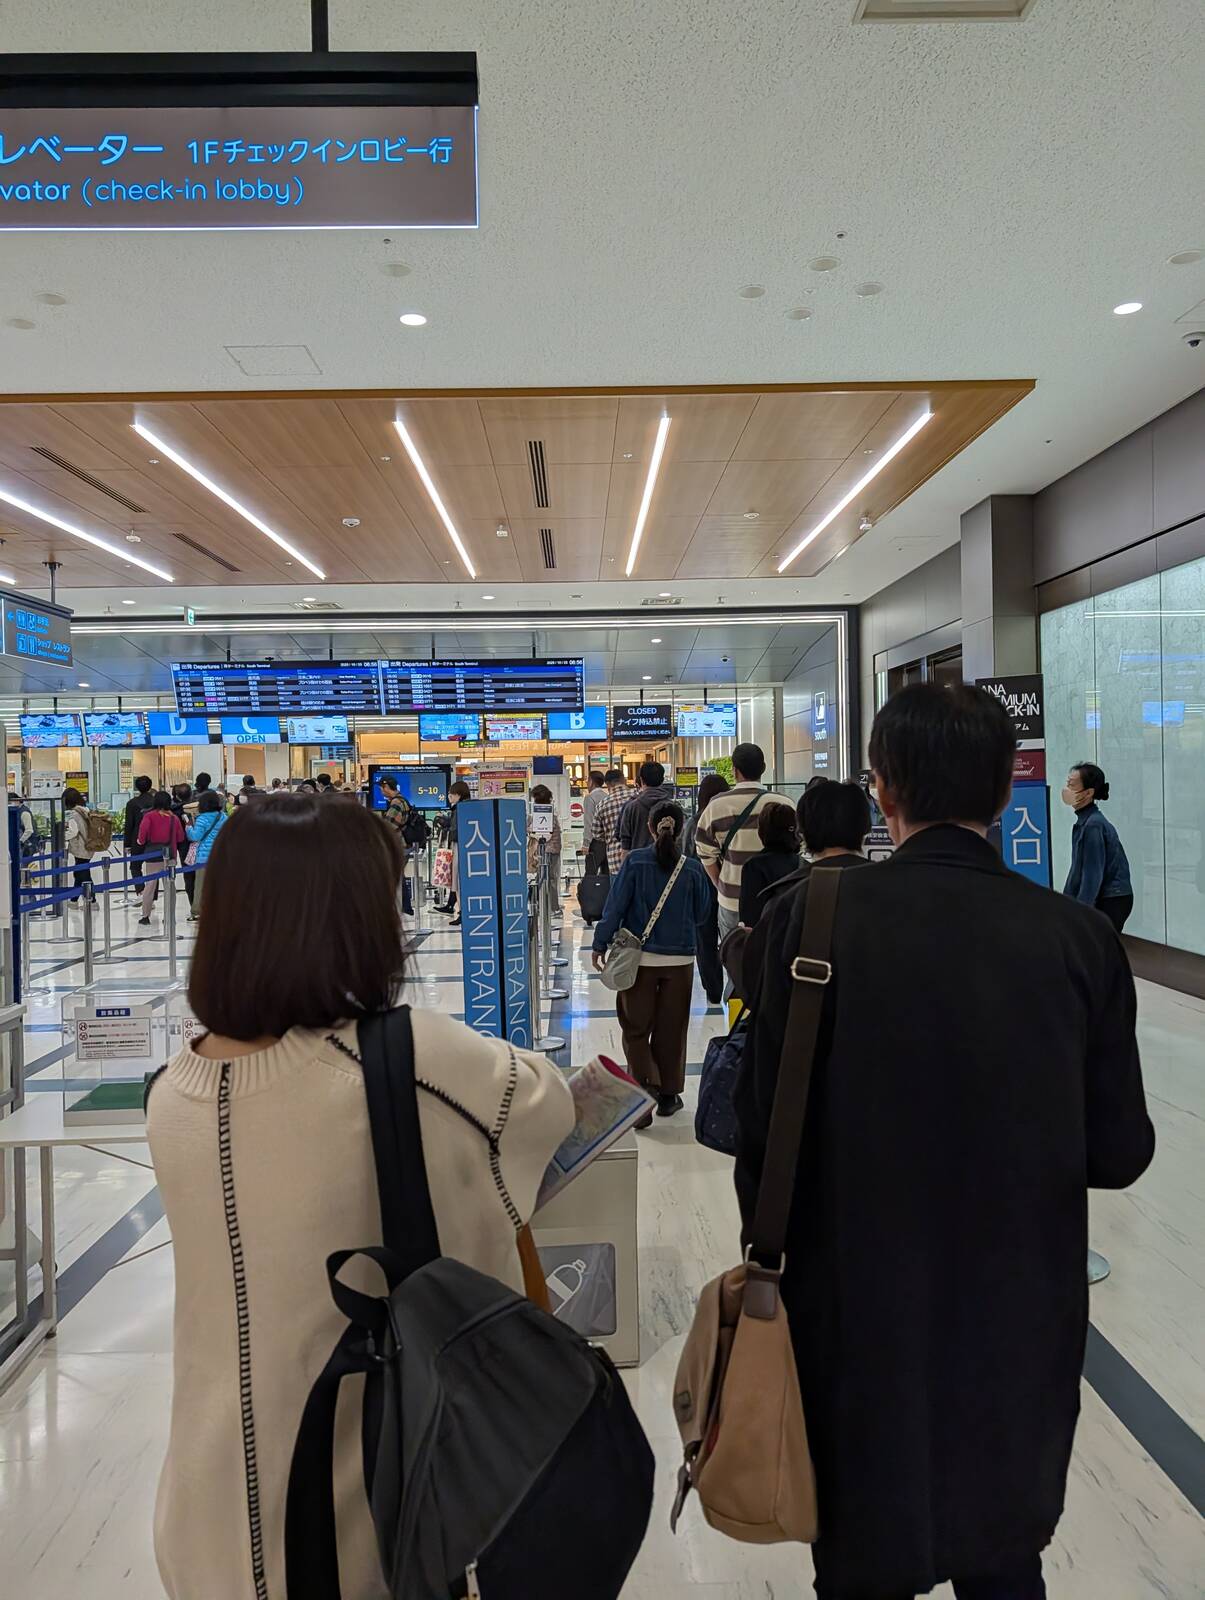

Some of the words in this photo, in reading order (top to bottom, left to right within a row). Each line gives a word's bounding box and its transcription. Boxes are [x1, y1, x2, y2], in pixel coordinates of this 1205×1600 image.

[187, 137, 454, 165] 1Fチェックインロビー行
[0, 181, 71, 201] vator
[82, 178, 207, 207] (check-in
[216, 177, 305, 206] lobby)
[627, 707, 657, 715] CLOSED
[994, 693, 1037, 706] MIUM
[1005, 703, 1040, 717] CK-IN
[168, 713, 187, 735] D
[569, 712, 586, 730] B
[616, 717, 668, 726] ナイフ持込禁止
[236, 734, 266, 743] OPEN
[503, 819, 522, 875] 入口
[1010, 807, 1043, 864] 入口
[465, 820, 491, 877] 入口
[467, 895, 497, 1041] ENTRAN
[505, 893, 528, 1050] ENTRANC
